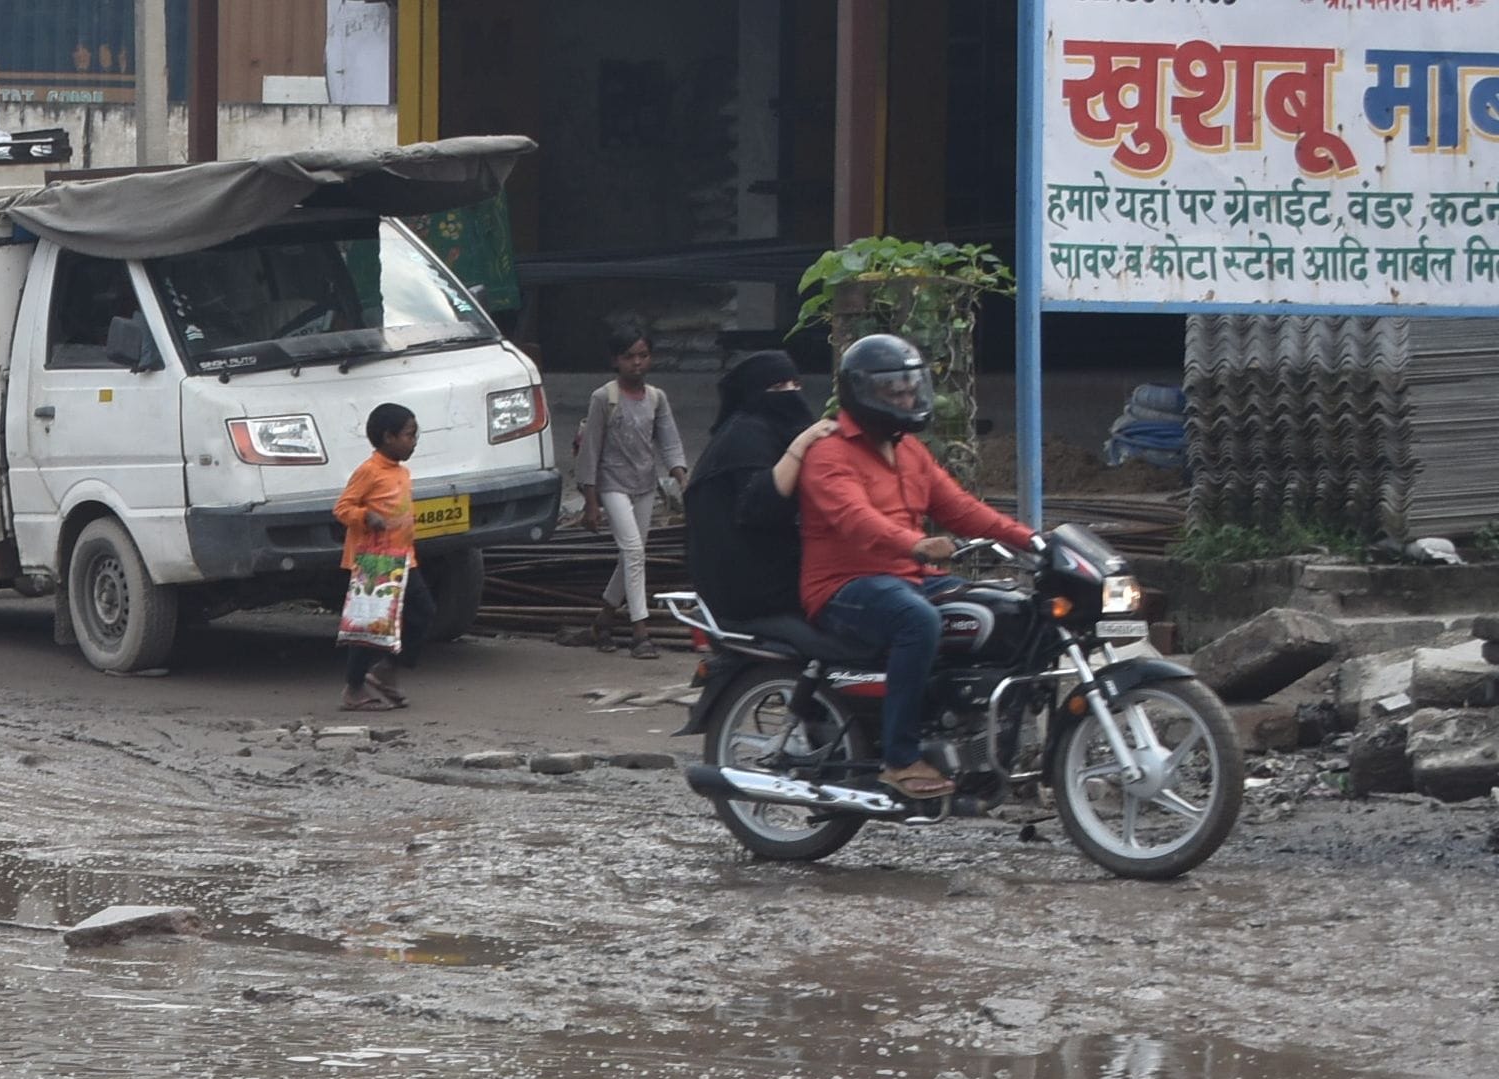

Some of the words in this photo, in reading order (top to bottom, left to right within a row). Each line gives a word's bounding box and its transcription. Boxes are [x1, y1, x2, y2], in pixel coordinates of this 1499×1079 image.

[1061, 38, 1359, 178] खुशबू
[1047, 170, 1111, 230] हमारे
[1176, 189, 1217, 225] पर
[1149, 233, 1217, 281] कोटा
[1223, 233, 1294, 282] स्टोन
[1303, 235, 1369, 285] आदि
[1376, 234, 1455, 284] मार्बल
